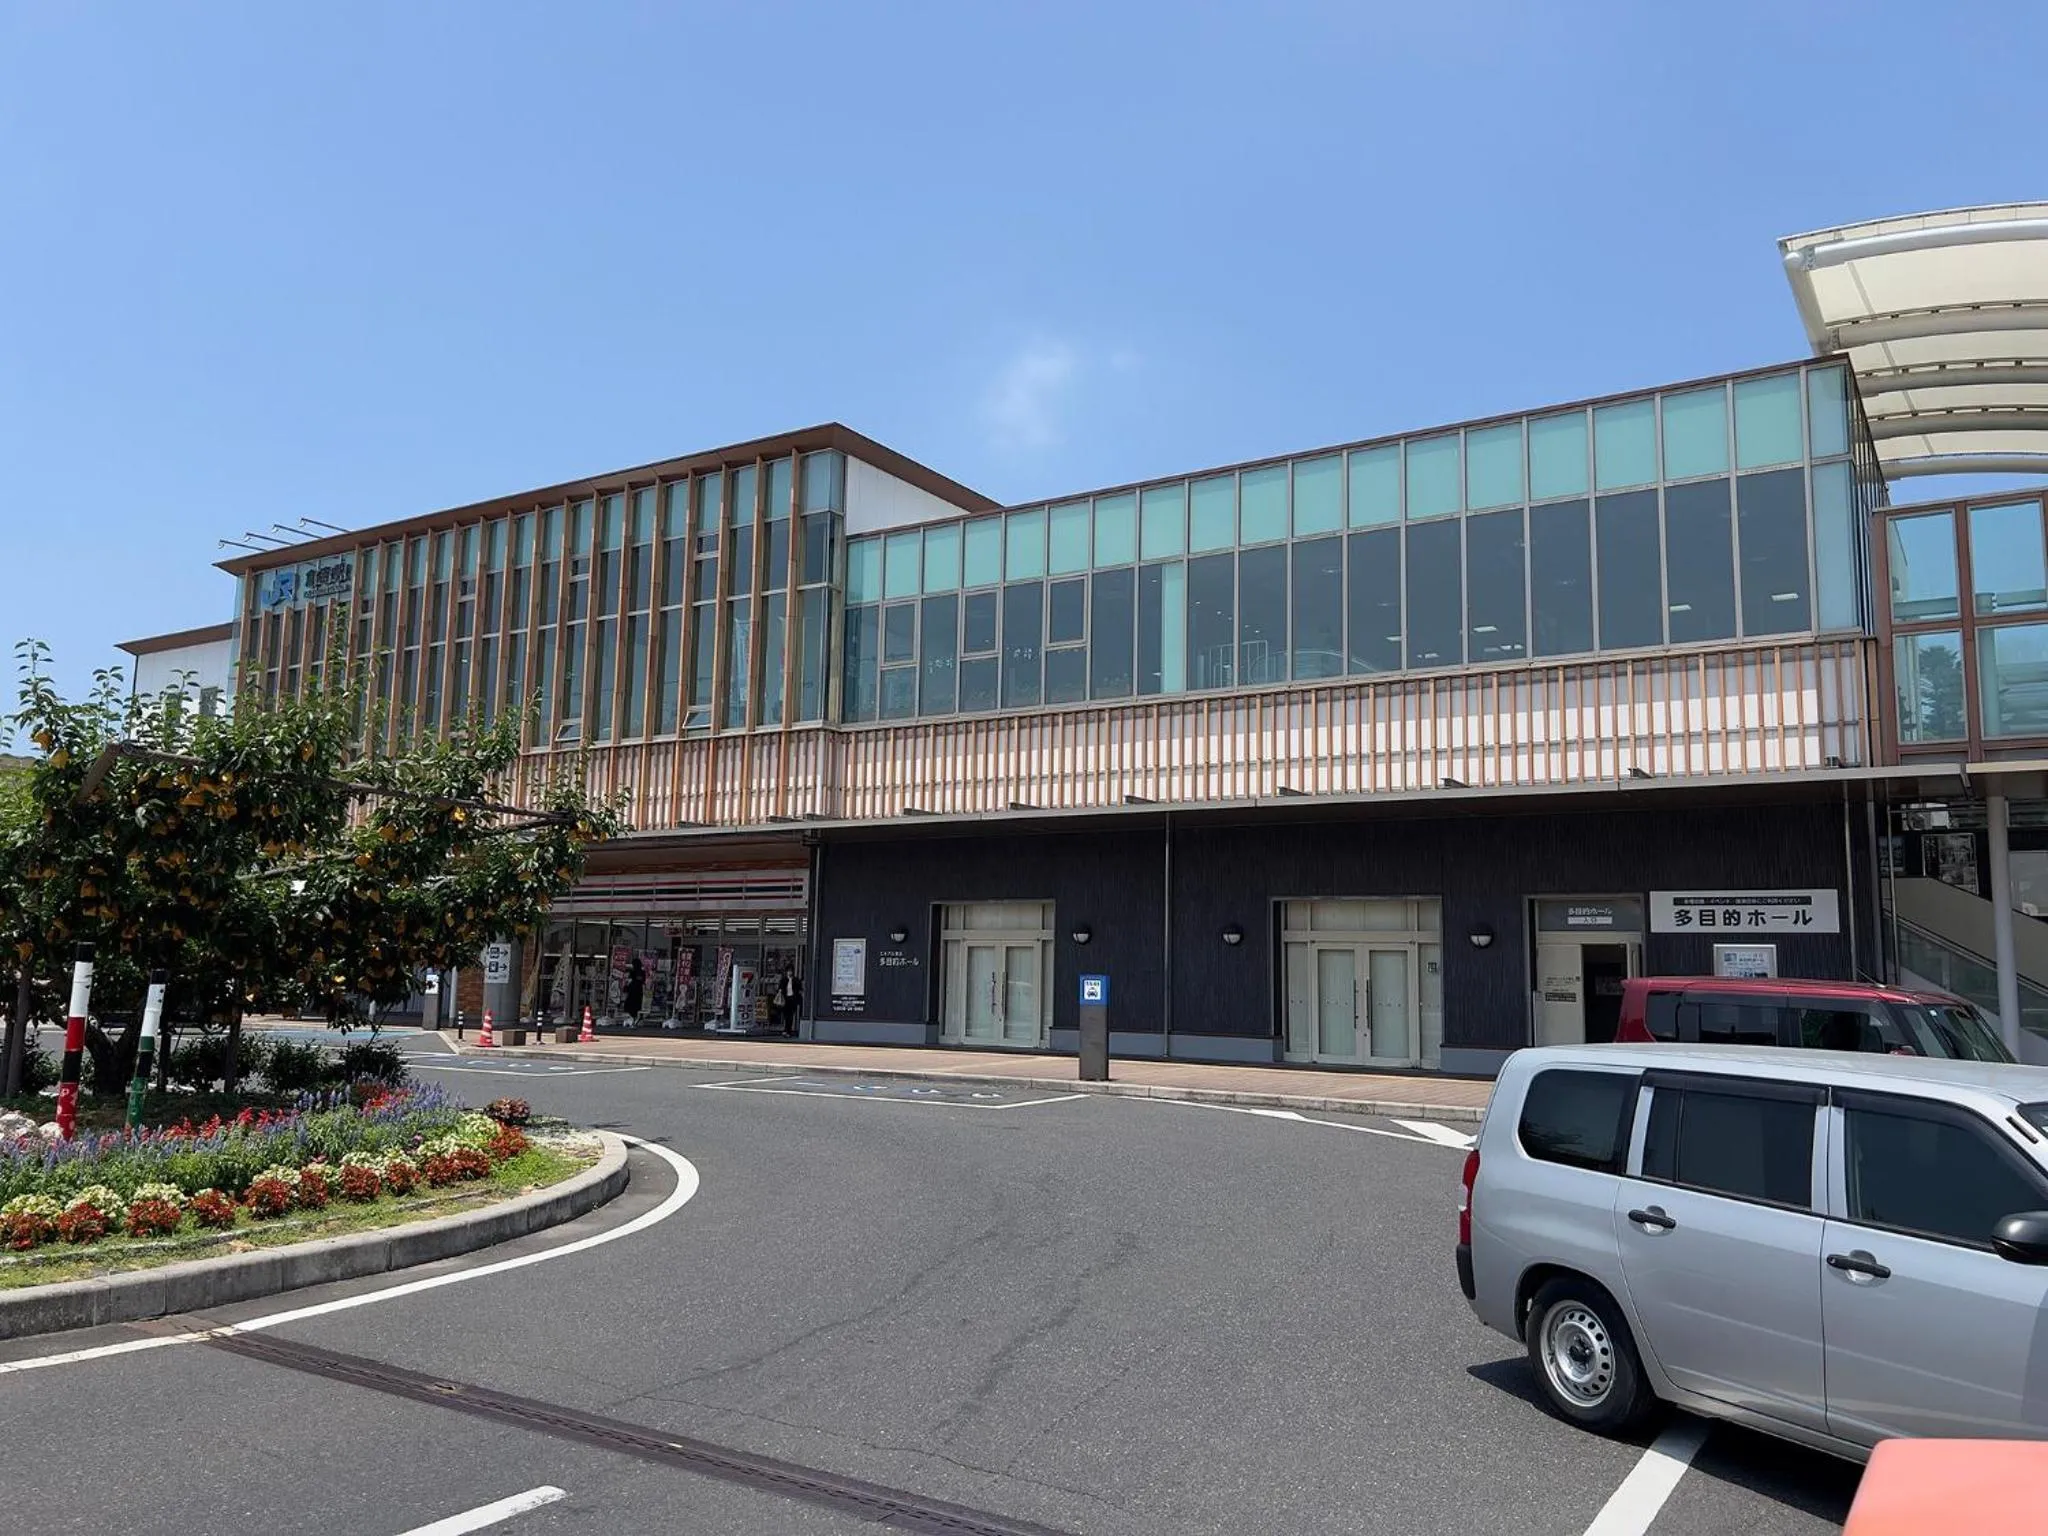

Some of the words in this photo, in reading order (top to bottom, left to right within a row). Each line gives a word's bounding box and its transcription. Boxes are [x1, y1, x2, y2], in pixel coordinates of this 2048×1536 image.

[1567, 906, 1613, 916] 多目的ホール
[1674, 908, 1813, 927] 多目的ホール
[879, 956, 920, 966] 多目的ホール
